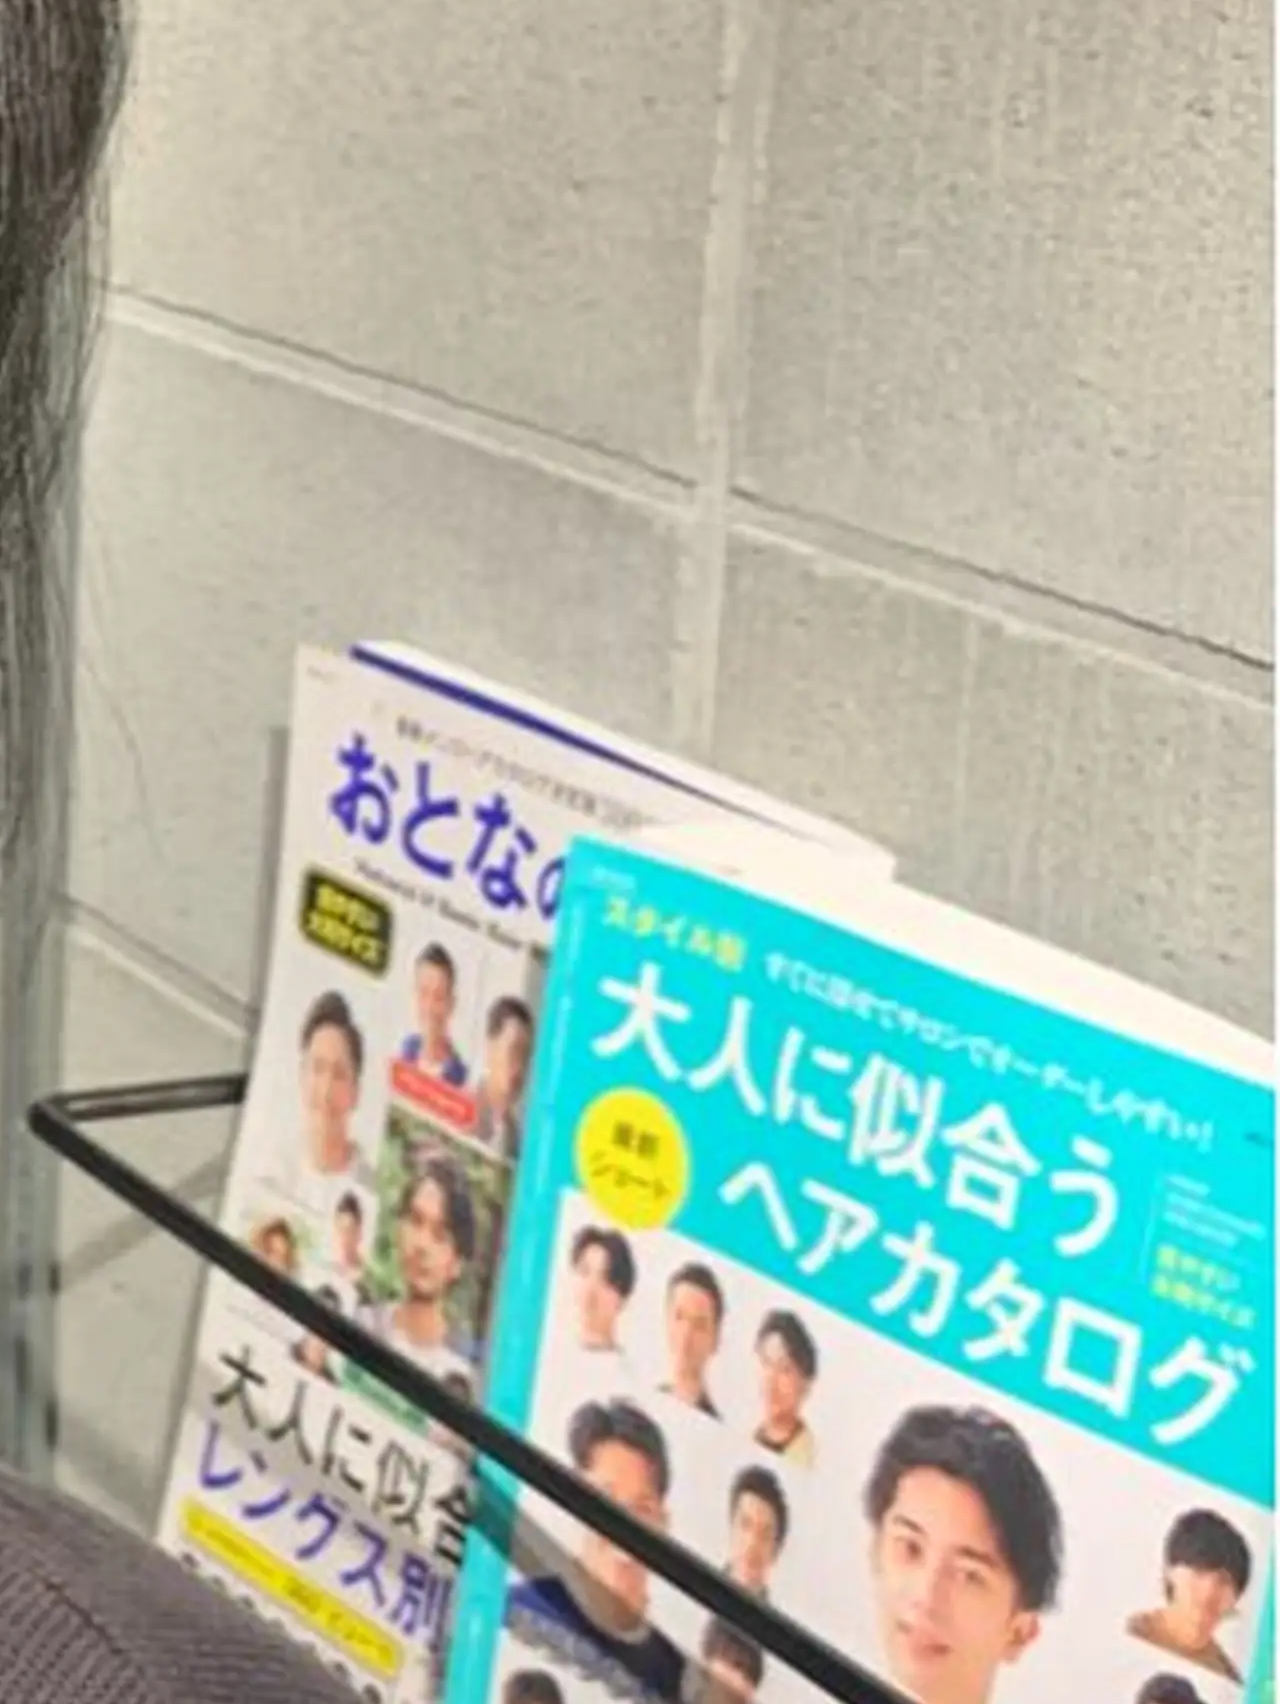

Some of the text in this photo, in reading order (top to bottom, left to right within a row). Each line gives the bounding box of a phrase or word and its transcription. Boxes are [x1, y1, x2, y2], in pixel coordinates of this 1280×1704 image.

[591, 962, 1119, 1258] 大人に似合う
[718, 1161, 1256, 1447] ヘアカタログ
